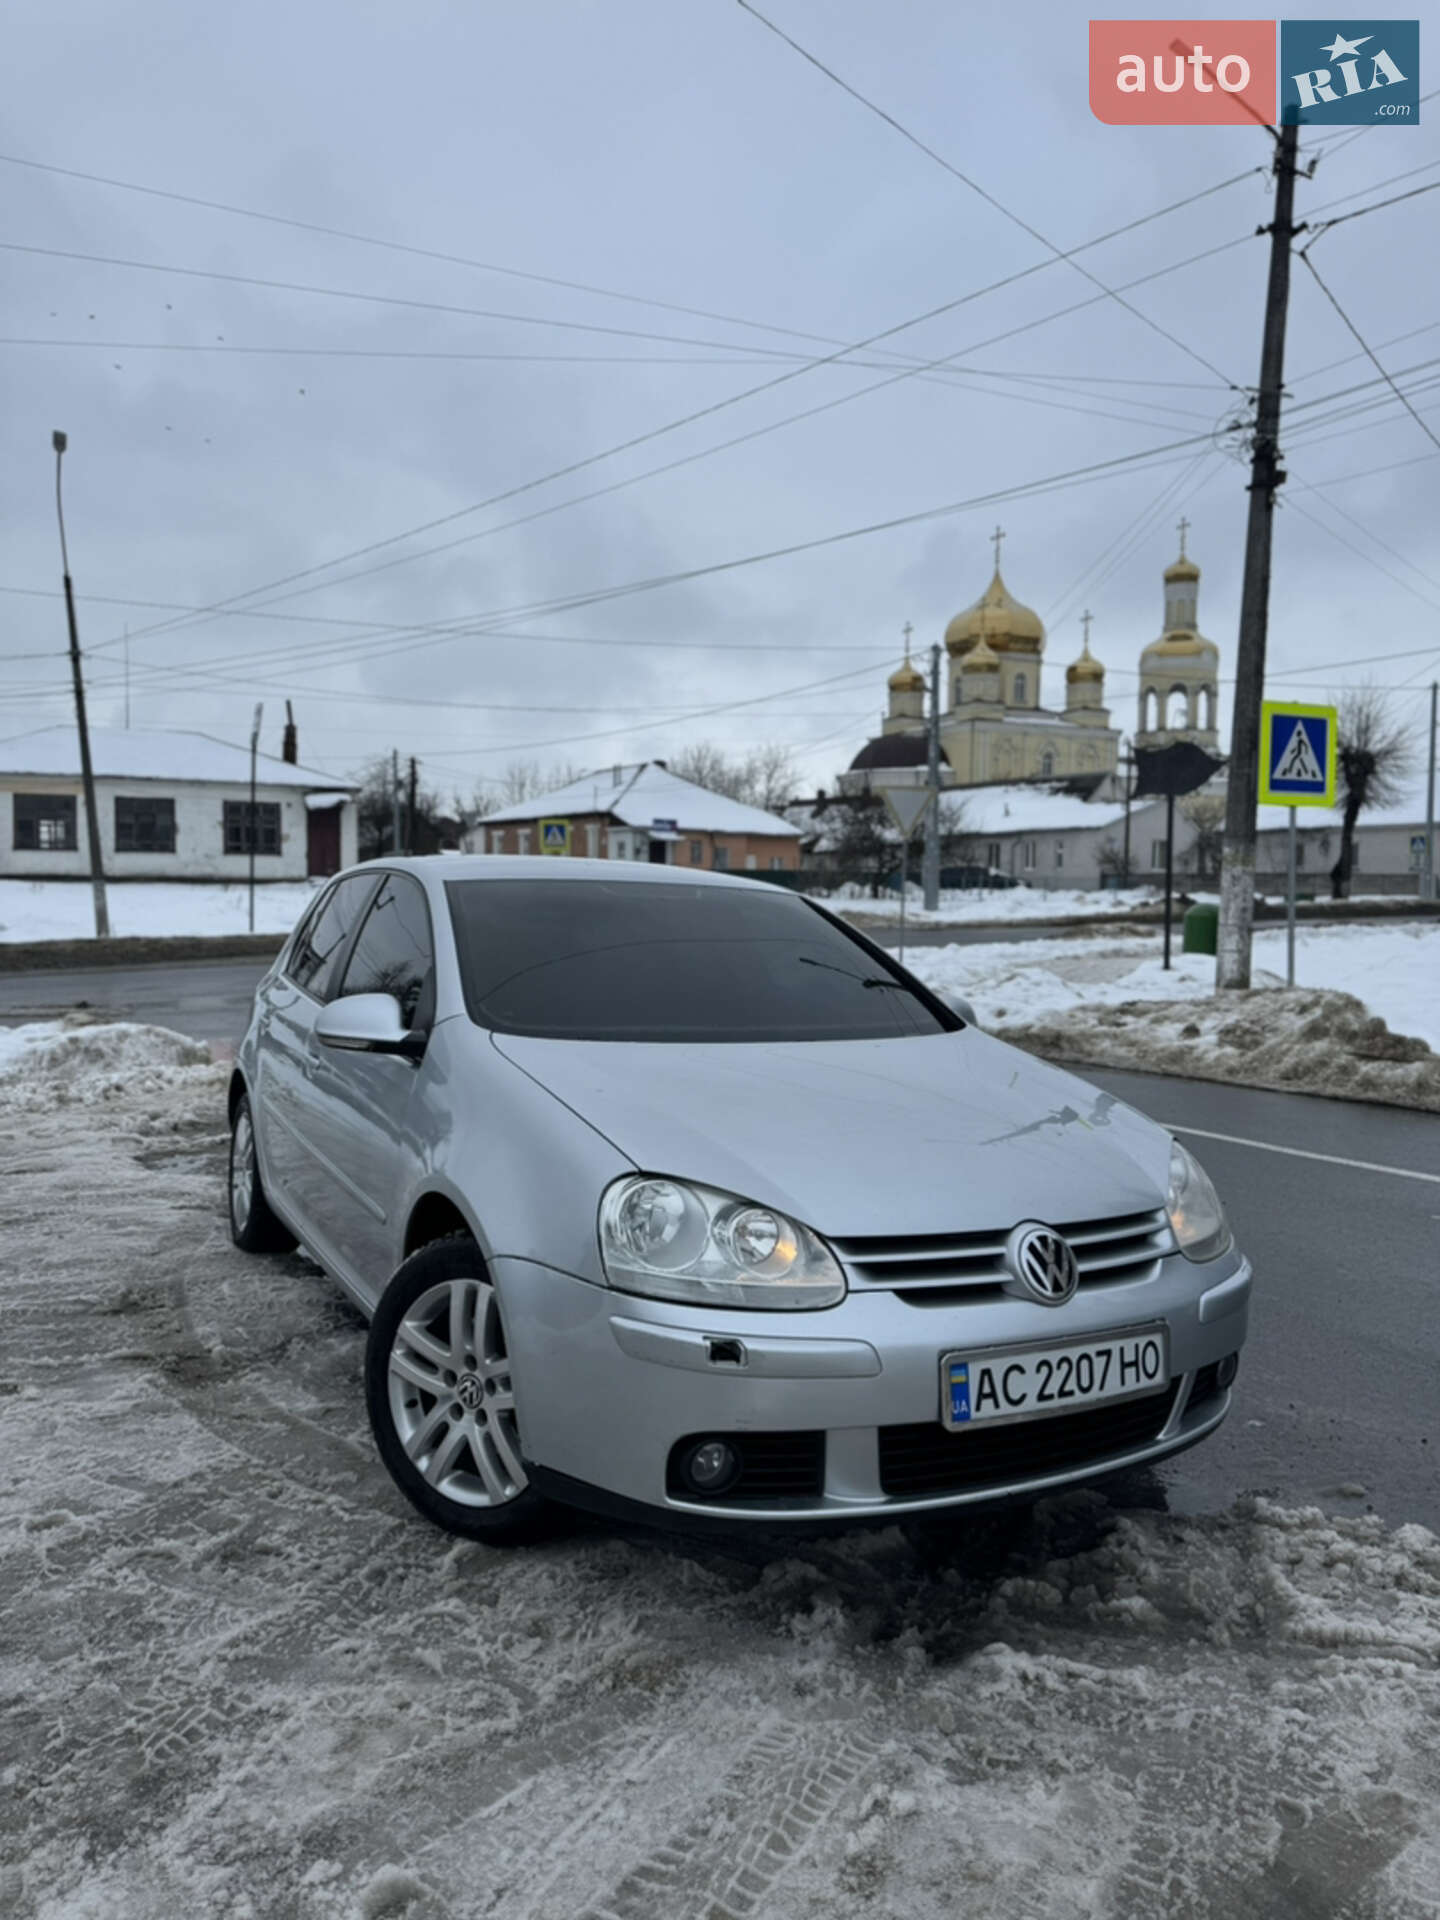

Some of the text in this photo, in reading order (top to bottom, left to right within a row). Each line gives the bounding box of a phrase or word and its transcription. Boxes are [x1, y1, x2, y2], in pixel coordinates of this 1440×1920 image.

[974, 1340, 1160, 1412] AC 2207 HO
